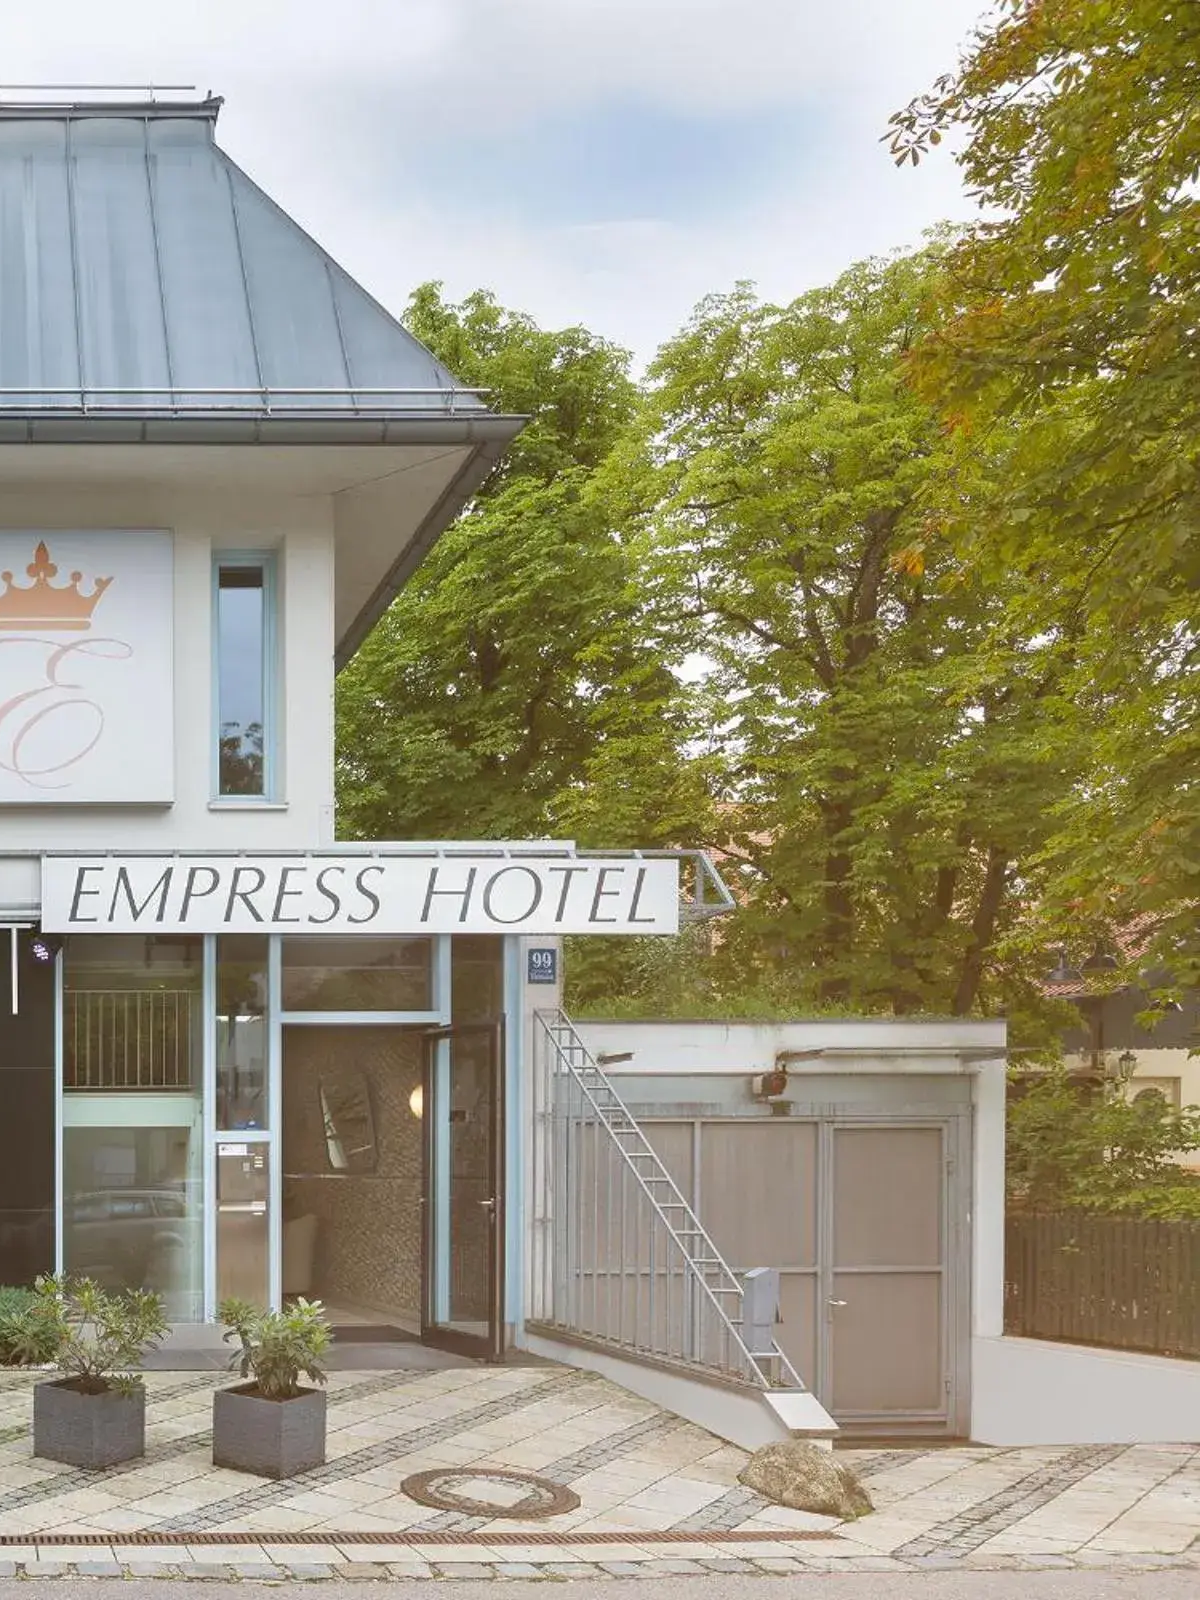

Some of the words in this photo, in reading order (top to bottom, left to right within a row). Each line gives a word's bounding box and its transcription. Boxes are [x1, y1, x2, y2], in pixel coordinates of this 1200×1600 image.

[67, 865, 385, 924] EMPRESS
[419, 865, 656, 924] HOTEL
[532, 952, 552, 969] 99
